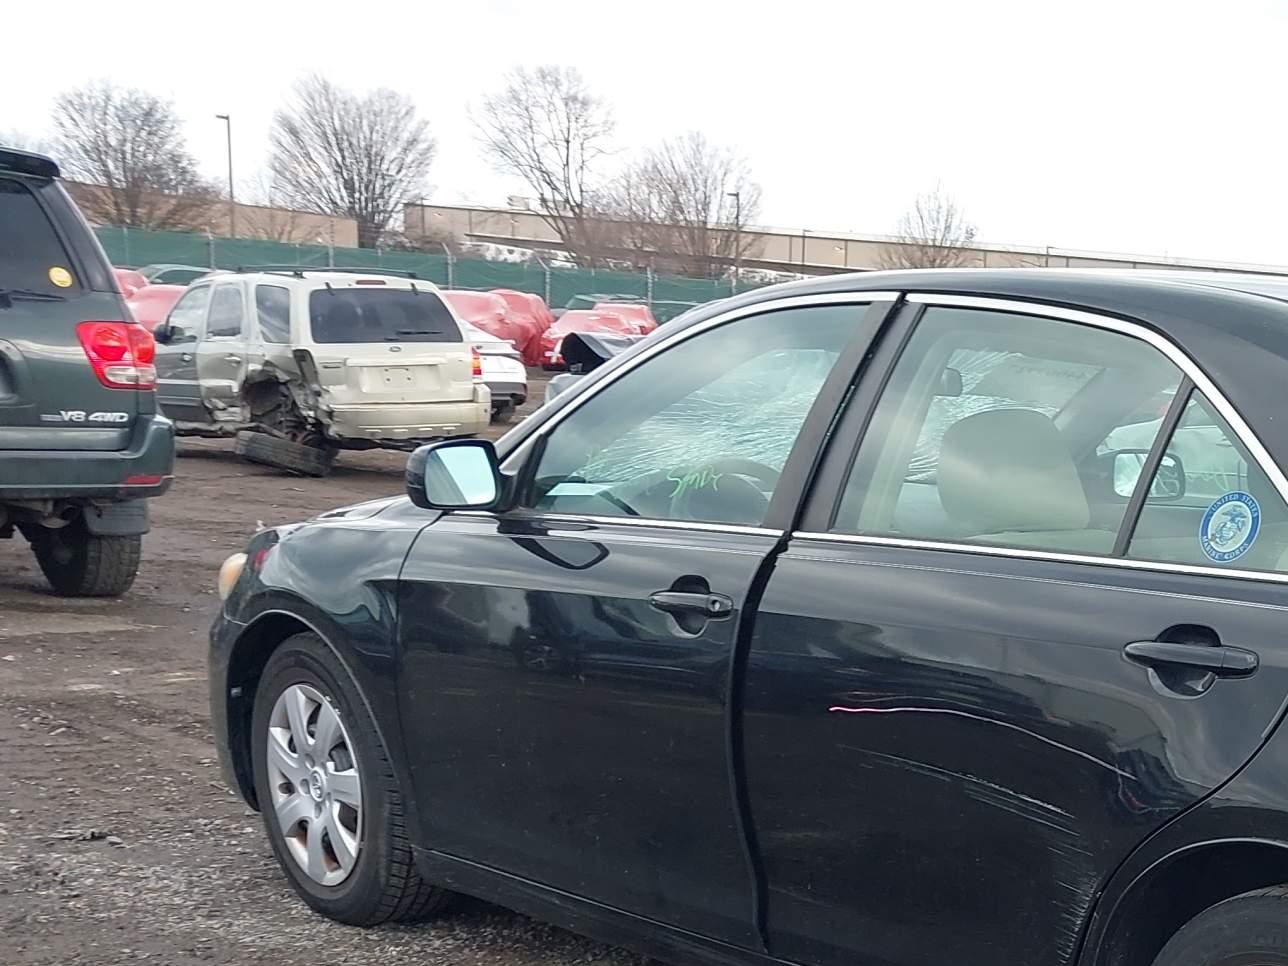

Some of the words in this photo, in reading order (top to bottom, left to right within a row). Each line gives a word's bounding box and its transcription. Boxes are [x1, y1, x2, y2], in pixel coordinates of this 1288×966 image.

[60, 411, 87, 422] V8
[88, 412, 129, 423] 4WD
[1211, 493, 1240, 513] UNITED
